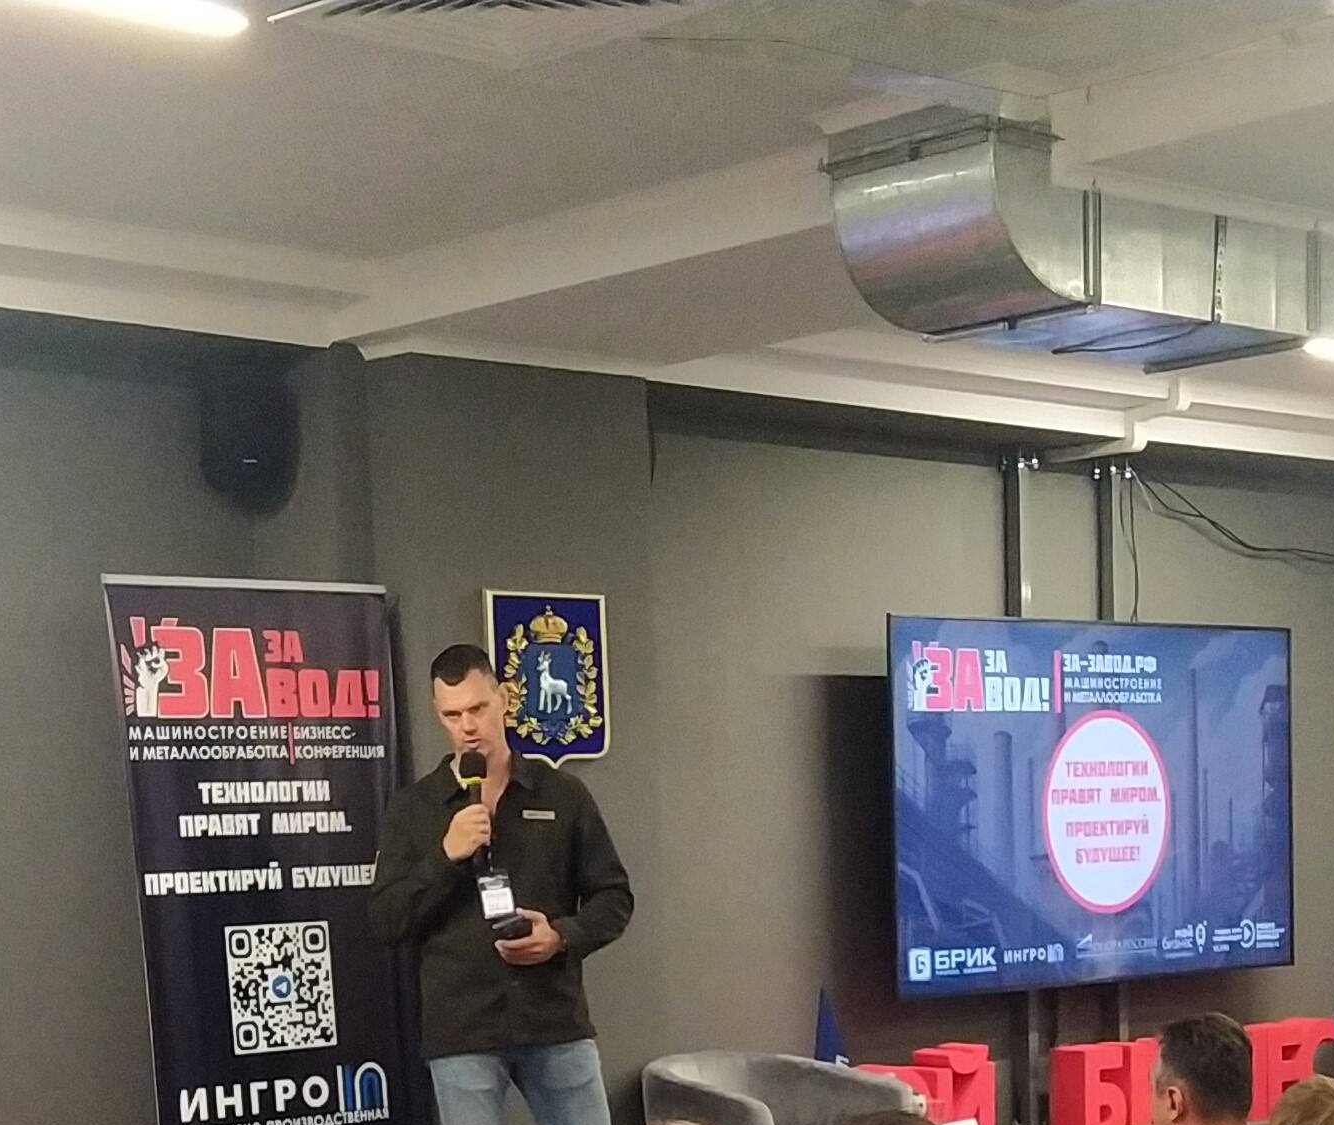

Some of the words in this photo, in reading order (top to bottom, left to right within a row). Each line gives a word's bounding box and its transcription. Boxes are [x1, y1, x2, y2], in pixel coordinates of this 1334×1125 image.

[262, 629, 305, 663] ЗА
[151, 625, 268, 719] ЗА
[983, 650, 1008, 673] ЗА
[266, 668, 381, 718] ВОД!
[984, 676, 1051, 713] ВОД!
[1063, 677, 1164, 691] МАШИНОСТРОЕНИЕ
[128, 725, 288, 742] МАШИНОСТРОЕНИЕ
[293, 725, 356, 741] БИЗНЕСС-
[129, 747, 140, 760] И
[142, 744, 289, 760] МЕТАЛЛООБРАБОТКА
[294, 744, 386, 760] КОНФЕРЕНЦИЯ
[1065, 760, 1149, 778] ТЕХНОЛОГИИ
[197, 780, 331, 805] ТЕХНОЛОГИИ
[1051, 788, 1102, 805] ПРАВЯТ
[178, 813, 262, 838] ПРАВЯТ
[271, 811, 353, 835] МИРОМ.
[1065, 813, 1149, 838] ПРОЕКТИРУЙ
[143, 861, 284, 897] ПРОЕКТИРУЙ
[934, 946, 998, 970] БРИК
